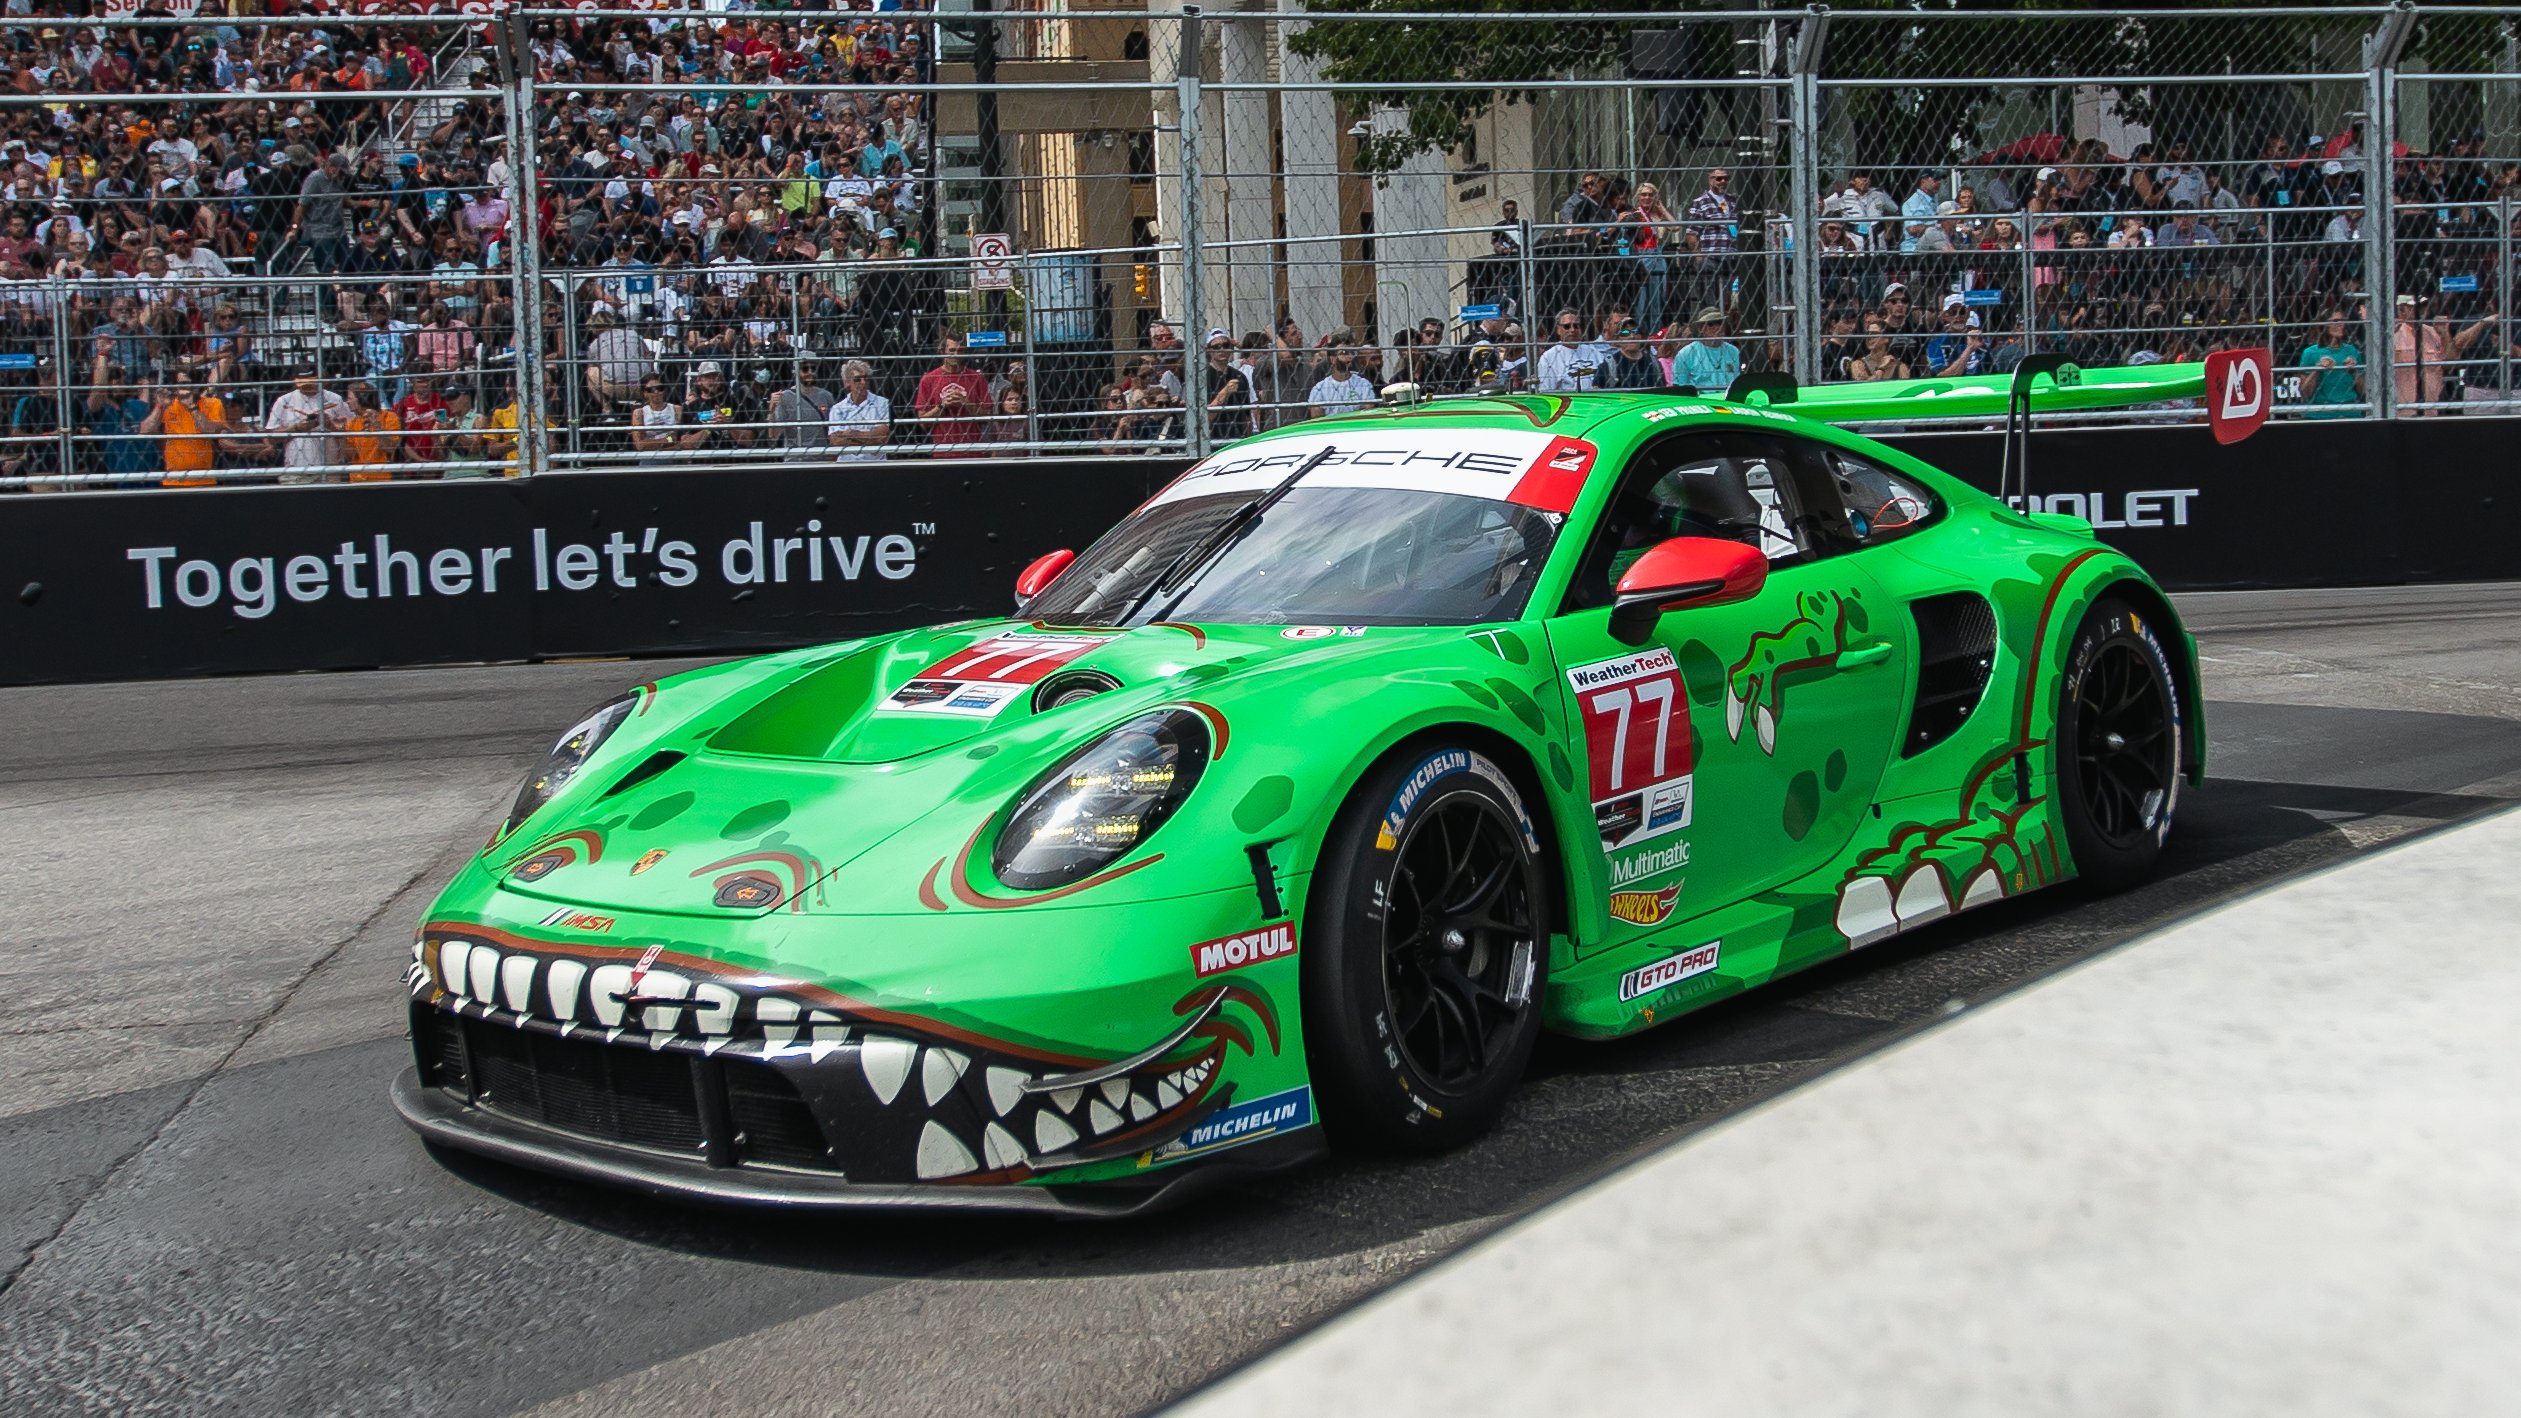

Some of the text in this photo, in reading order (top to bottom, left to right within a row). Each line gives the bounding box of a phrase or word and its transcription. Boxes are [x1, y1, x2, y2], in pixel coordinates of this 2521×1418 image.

[127, 534, 511, 618] Together
[534, 527, 698, 591] let's
[722, 520, 916, 585] drive
[940, 641, 1088, 679] 77
[1573, 651, 1673, 686] WeatherTech
[1591, 677, 1675, 792] 77
[1399, 752, 1466, 813] MICHELIN
[1613, 838, 1691, 884] Multimatic
[560, 913, 616, 934] IMSA
[1200, 926, 1293, 973] MOTUL
[1680, 947, 1716, 974] PRO
[1191, 1102, 1297, 1145] MICHELIN
